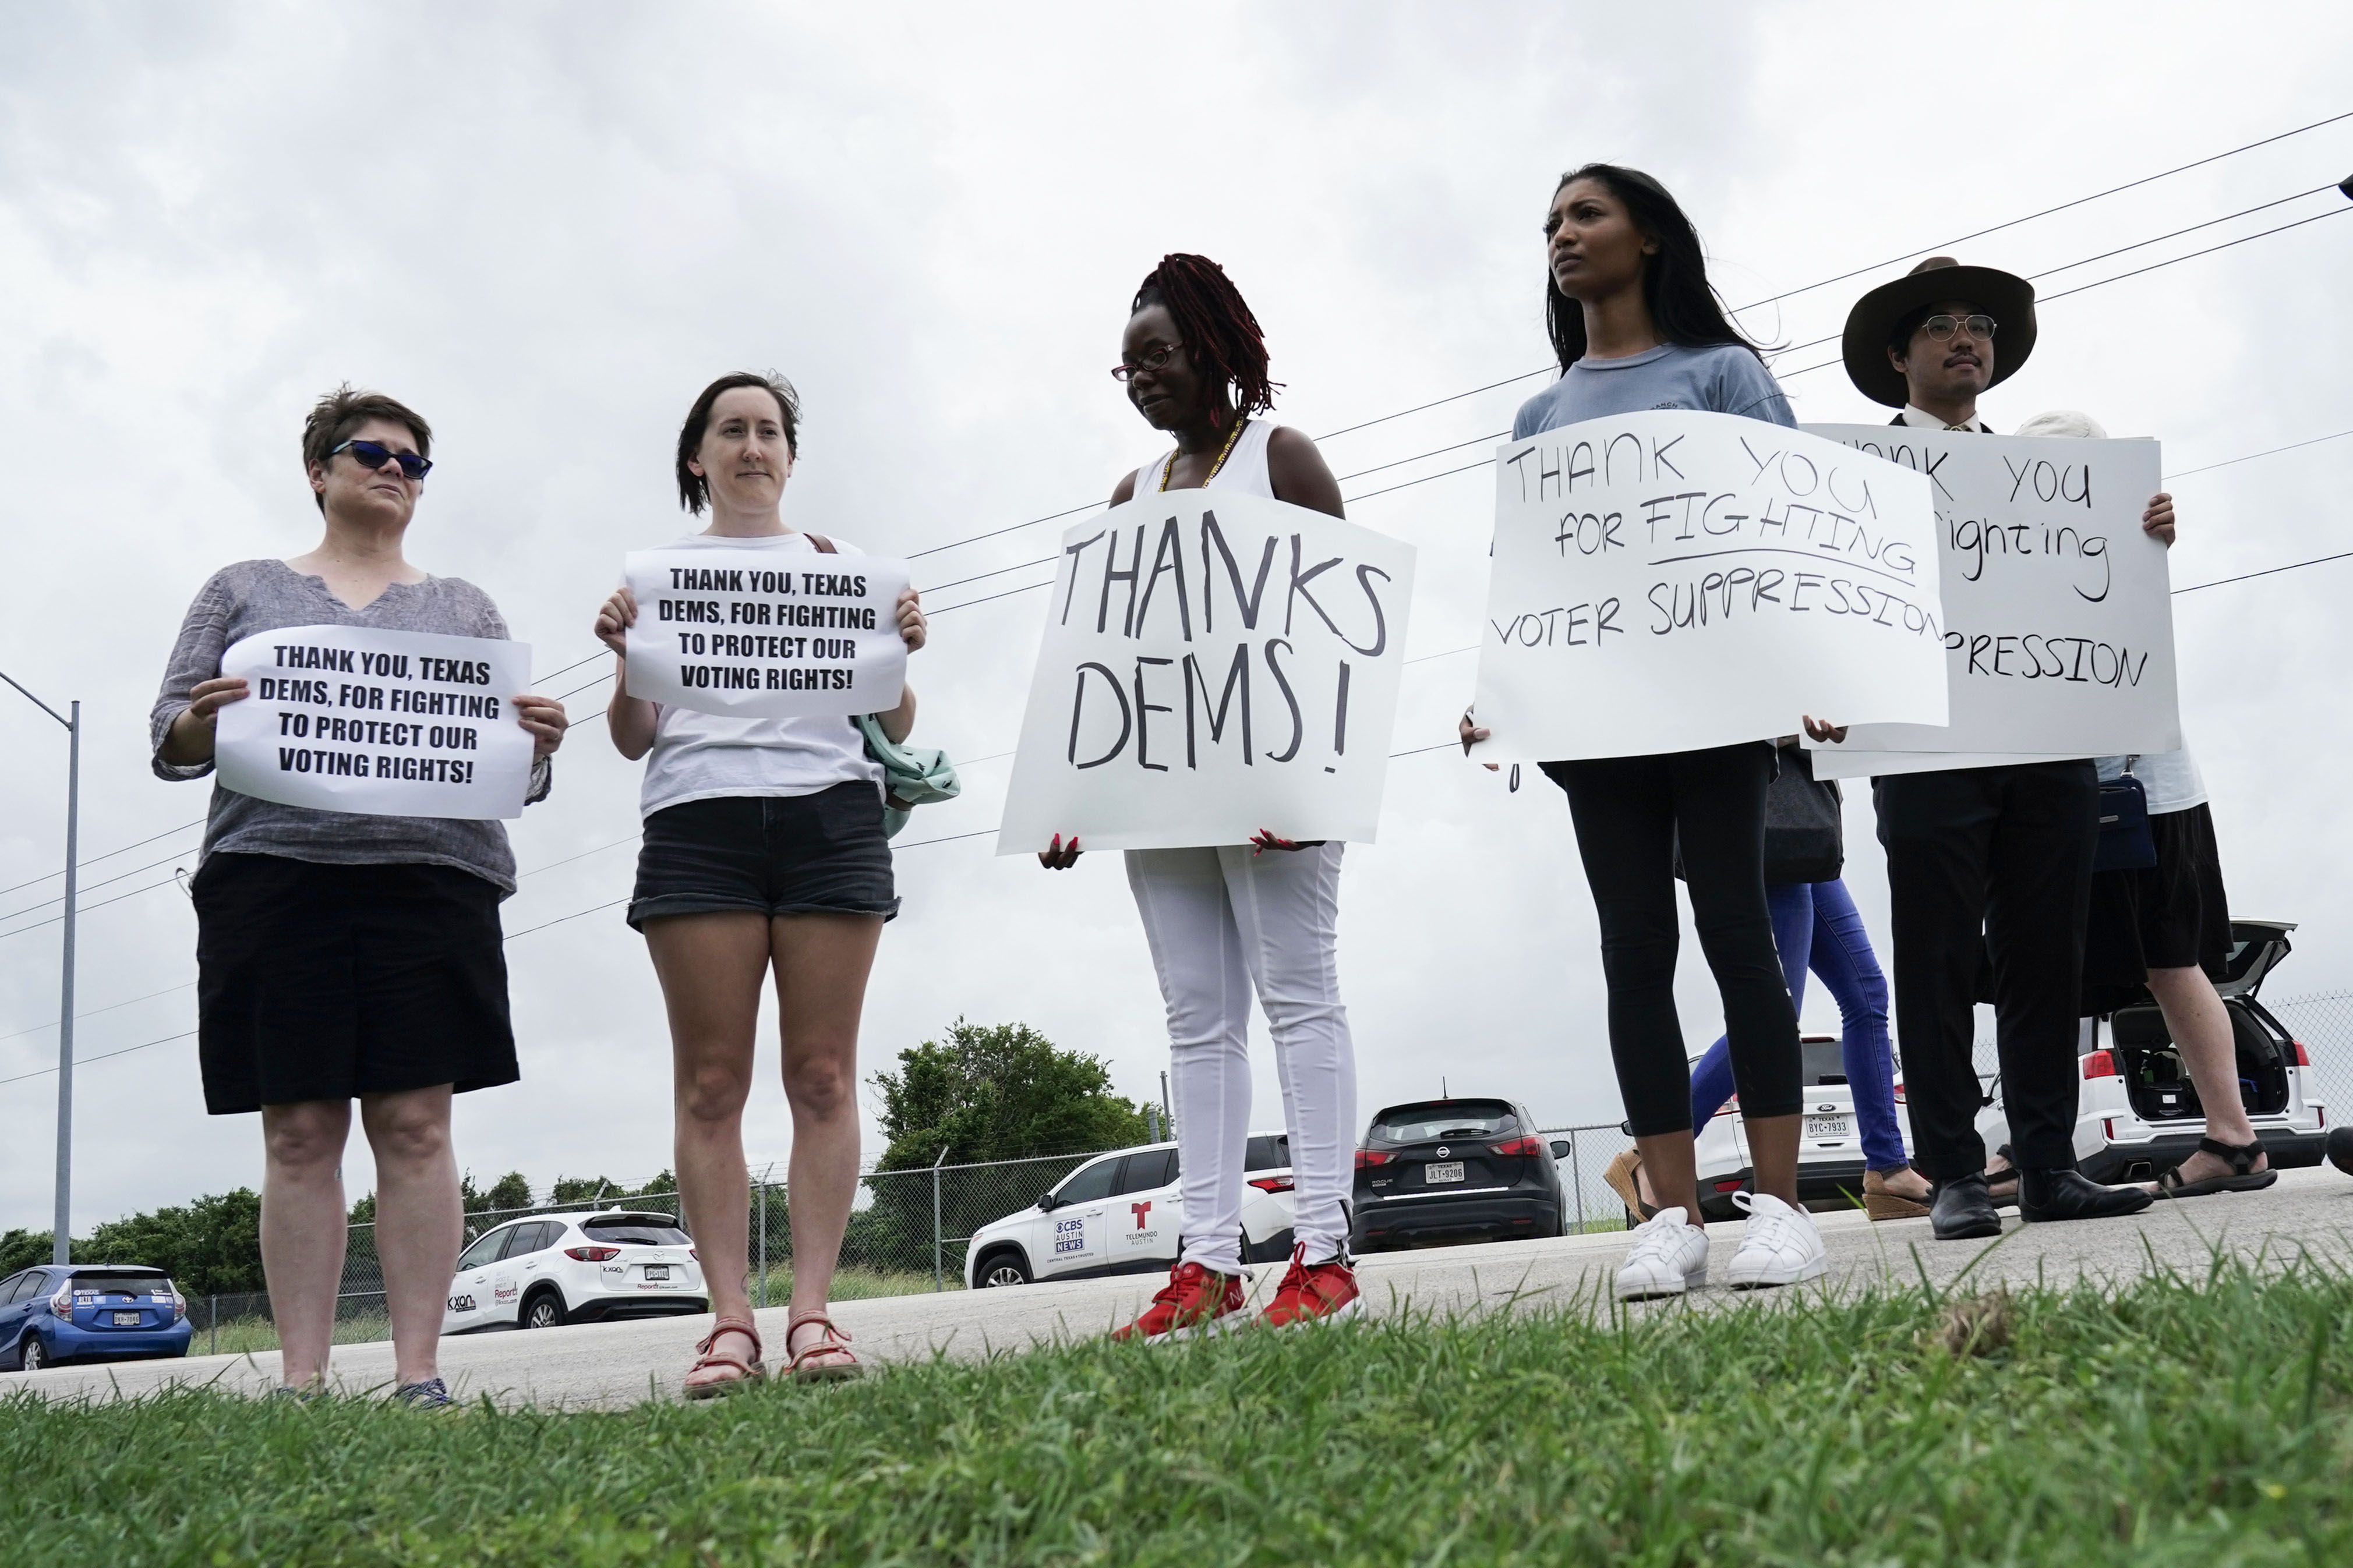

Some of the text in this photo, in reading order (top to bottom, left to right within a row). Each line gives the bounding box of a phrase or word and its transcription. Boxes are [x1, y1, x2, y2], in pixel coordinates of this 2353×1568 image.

[1507, 433, 1684, 503] THANK
[1740, 436, 1877, 519] YOU
[2004, 455, 2091, 508] YOU
[1555, 491, 1915, 574] FOR FIGHTING
[1934, 511, 2110, 603] ighting
[670, 568, 867, 597] THANK YOU, TEXAS
[1061, 509, 1391, 657] THANKS
[659, 599, 875, 630] DEMS, FOR FIGHTING
[1491, 568, 1945, 647] VOTER SUPPRESSION
[679, 633, 855, 659] TO PROTECT OUR
[274, 646, 490, 685] THANK YOU, TEXAS
[681, 666, 853, 689] VOTING RIGHTS!
[260, 678, 500, 720] DEMS, FOR FIGHTING
[1068, 638, 1350, 773] DEMS!
[278, 712, 476, 750] TO PROTECT OUR
[280, 748, 474, 784] VOTING RIGHTS!
[1056, 1231, 1083, 1241] AUSTIN
[1064, 1220, 1082, 1231] CBS
[1126, 1231, 1158, 1240] TELEMUNDO
[1057, 1240, 1082, 1252] NEWS
